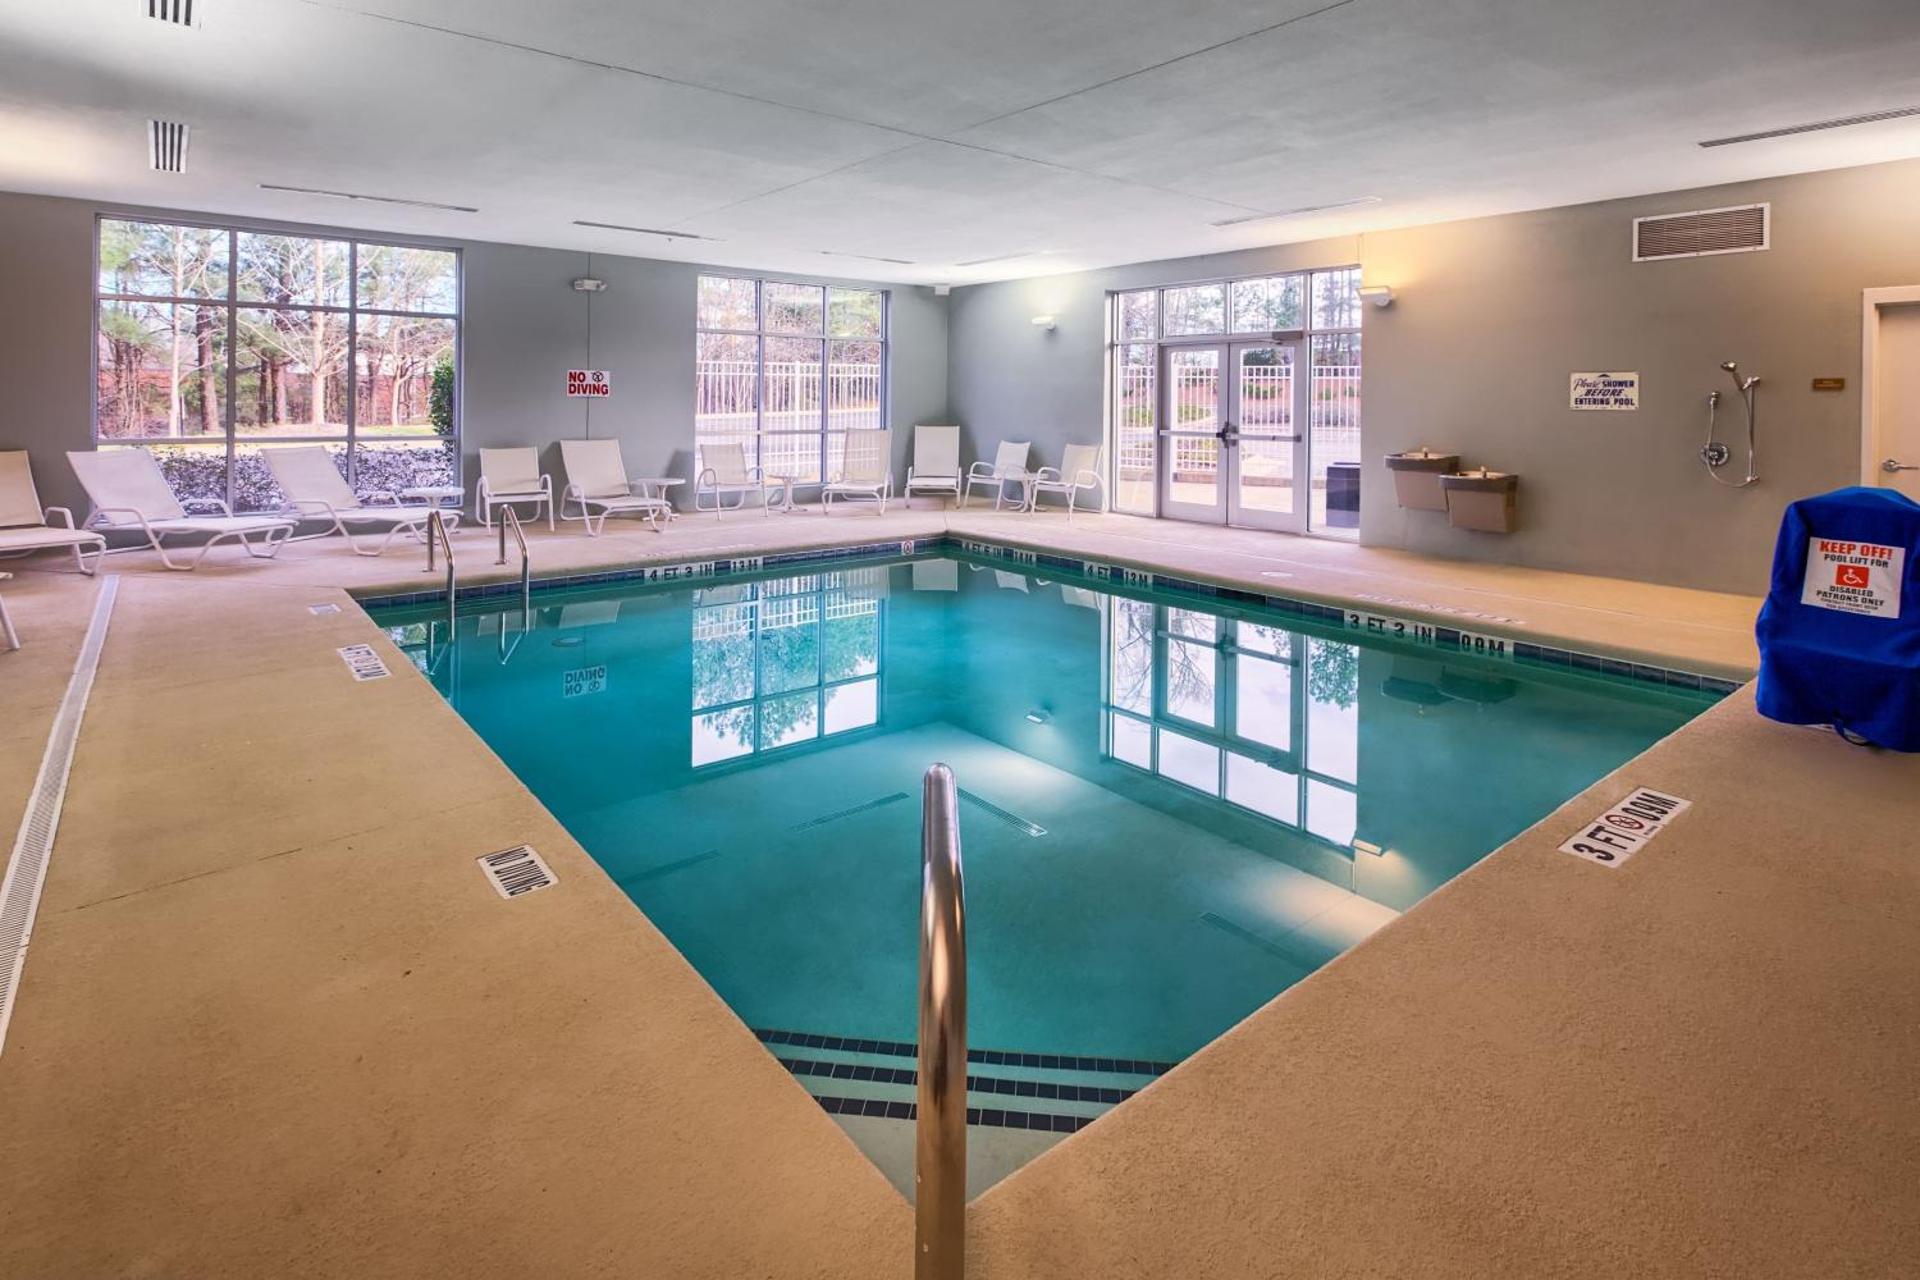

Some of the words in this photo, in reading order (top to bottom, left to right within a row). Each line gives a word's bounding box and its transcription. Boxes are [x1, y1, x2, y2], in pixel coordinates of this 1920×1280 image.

[569, 371, 586, 383] NO
[1602, 380, 1635, 388] SHOWER
[569, 383, 609, 395] DIVING
[1584, 388, 1625, 397] BEFORE
[1574, 397, 1611, 406] ENTERING
[1613, 397, 1635, 406] POOL
[1820, 540, 1857, 555] KEEP
[1861, 544, 1893, 560] OFF!
[1824, 553, 1848, 562] POOL
[1849, 556, 1868, 565] LIFT
[1870, 558, 1889, 568] FOR
[1816, 589, 1860, 603] PATRONS
[1861, 597, 1885, 607] ONLY
[1829, 585, 1874, 597] DISABLED
[1586, 825, 1637, 850] FT
[484, 846, 529, 867] NO
[1572, 843, 1616, 861] 3
[493, 859, 551, 897] DIVING
